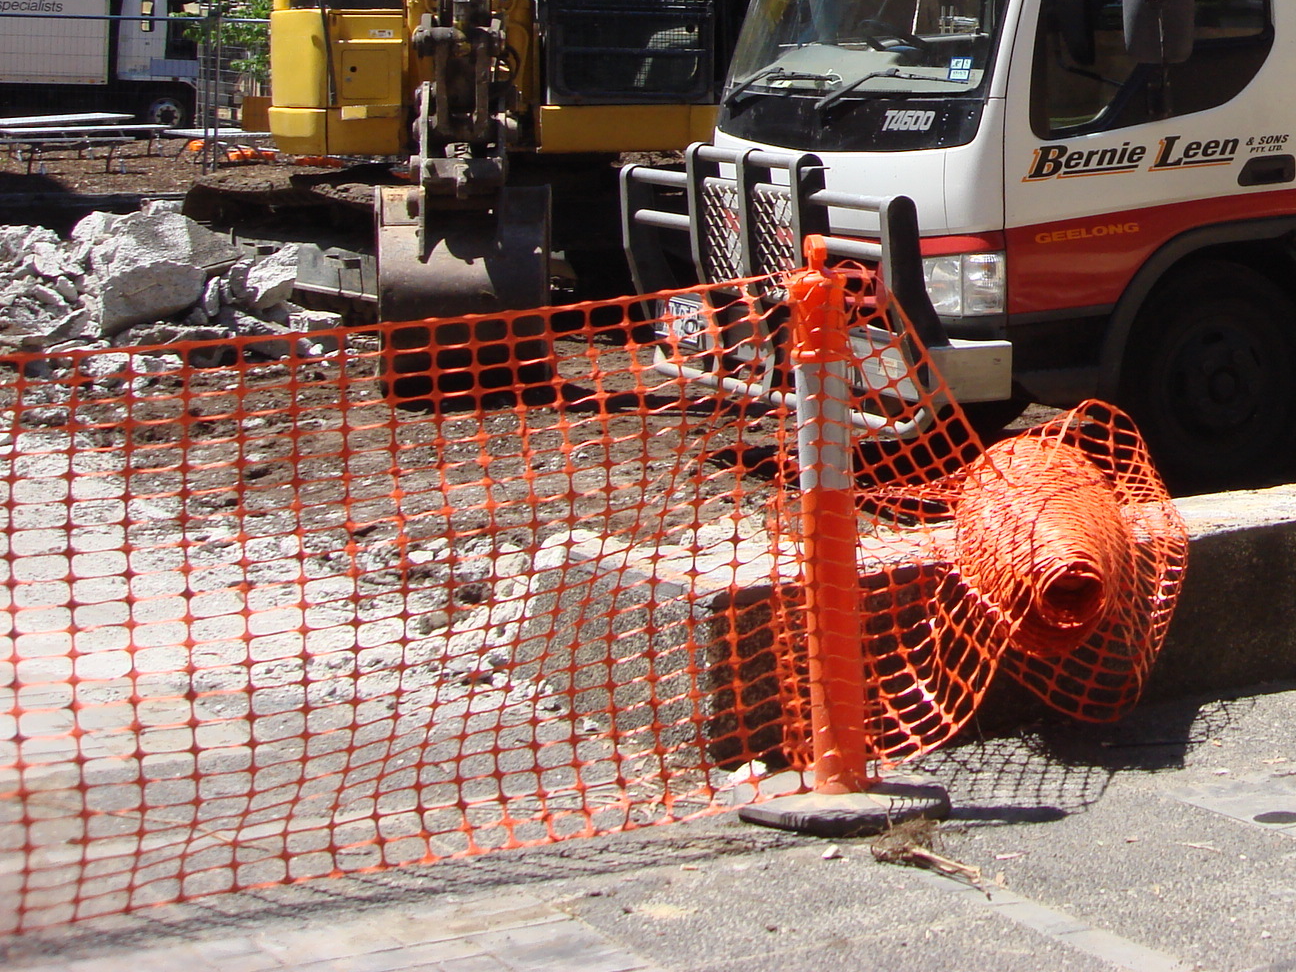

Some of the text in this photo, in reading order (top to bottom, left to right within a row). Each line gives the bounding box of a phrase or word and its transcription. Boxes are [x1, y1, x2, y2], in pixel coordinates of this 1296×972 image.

[881, 110, 936, 131] T4600
[1246, 134, 1290, 146] & SONS
[1021, 135, 1240, 182] Bernie Leen
[1035, 222, 1140, 244] GEELONG
